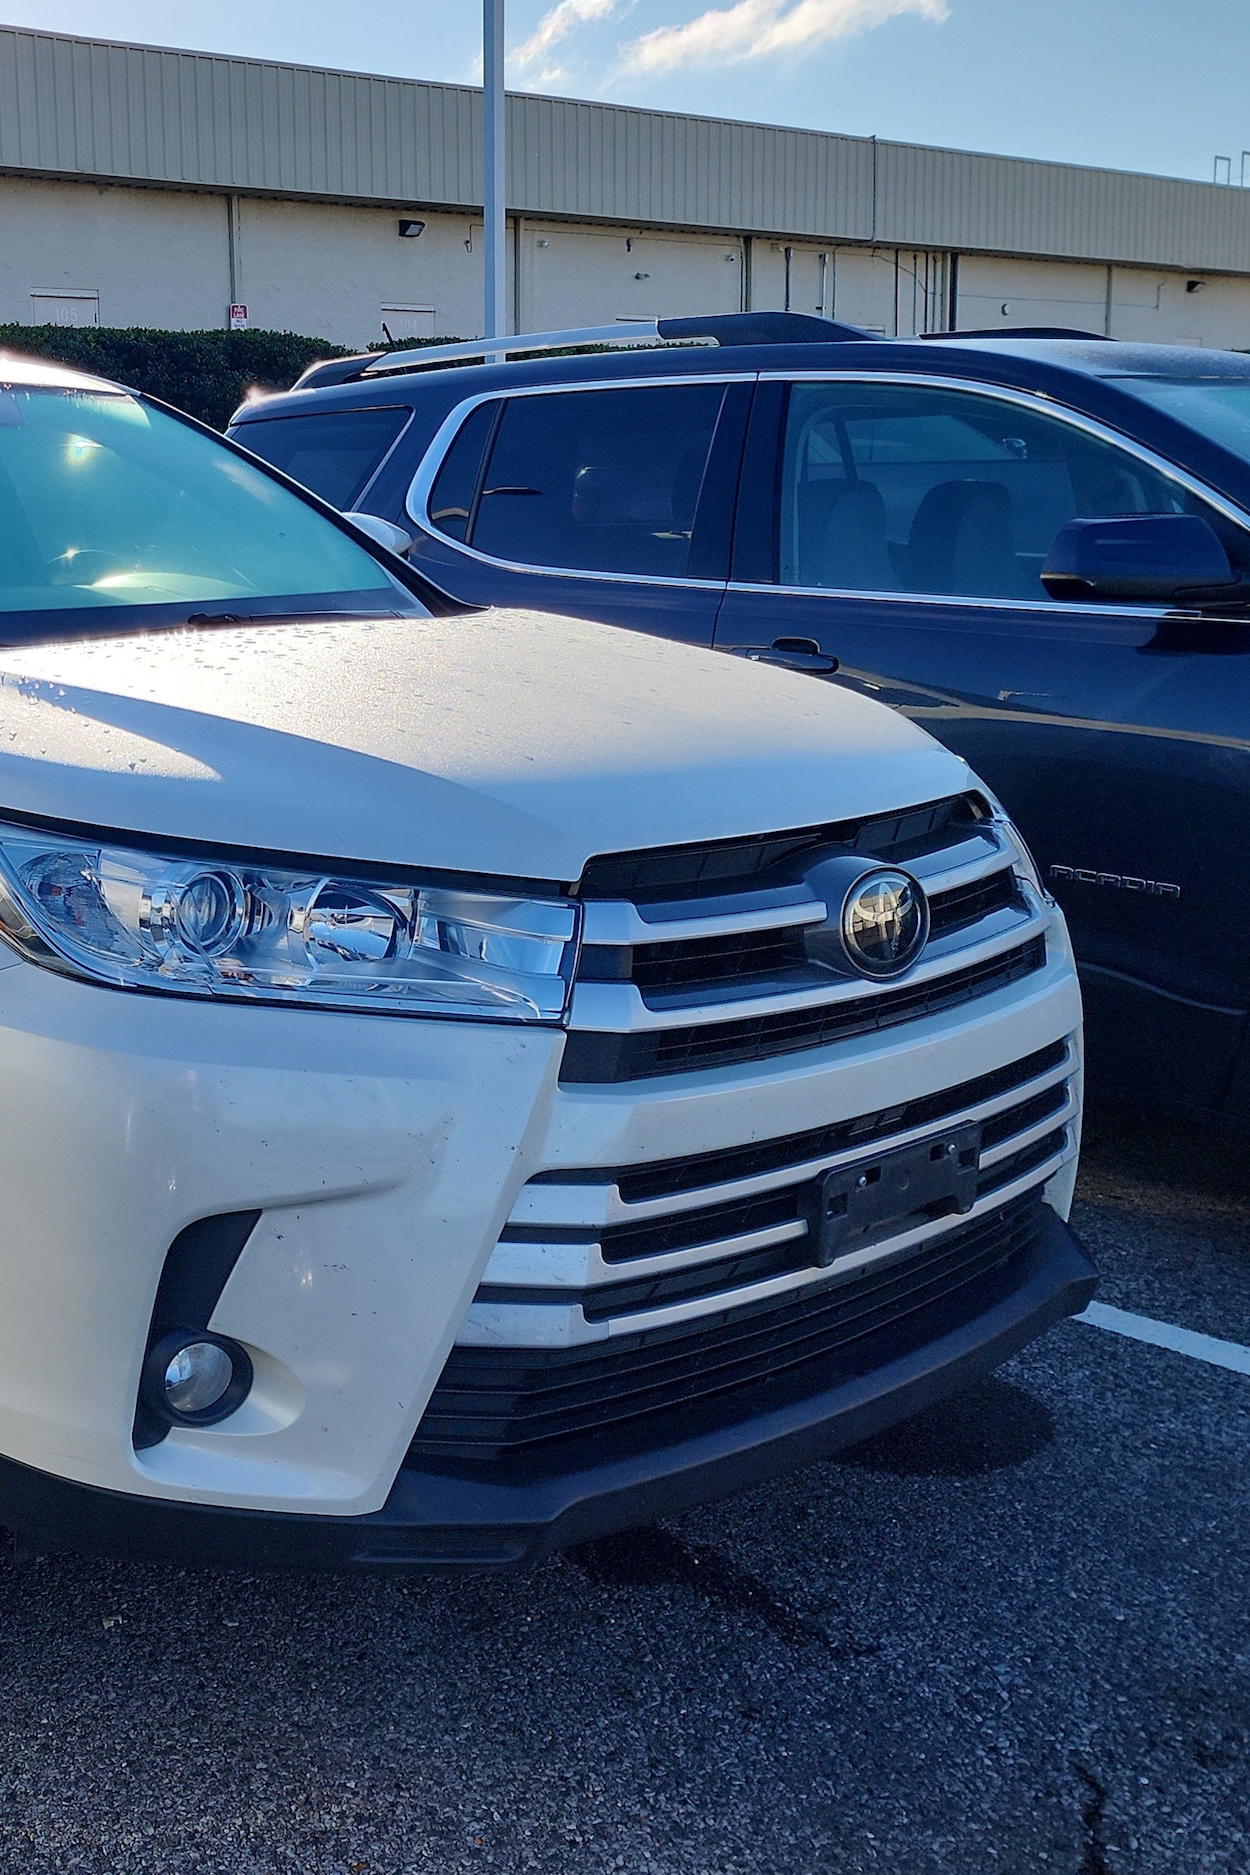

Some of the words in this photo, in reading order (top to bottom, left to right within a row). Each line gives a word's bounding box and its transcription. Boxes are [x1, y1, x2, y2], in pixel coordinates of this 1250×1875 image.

[54, 306, 78, 323] 105
[398, 320, 418, 333] 104
[1050, 864, 1181, 899] ACADIA
